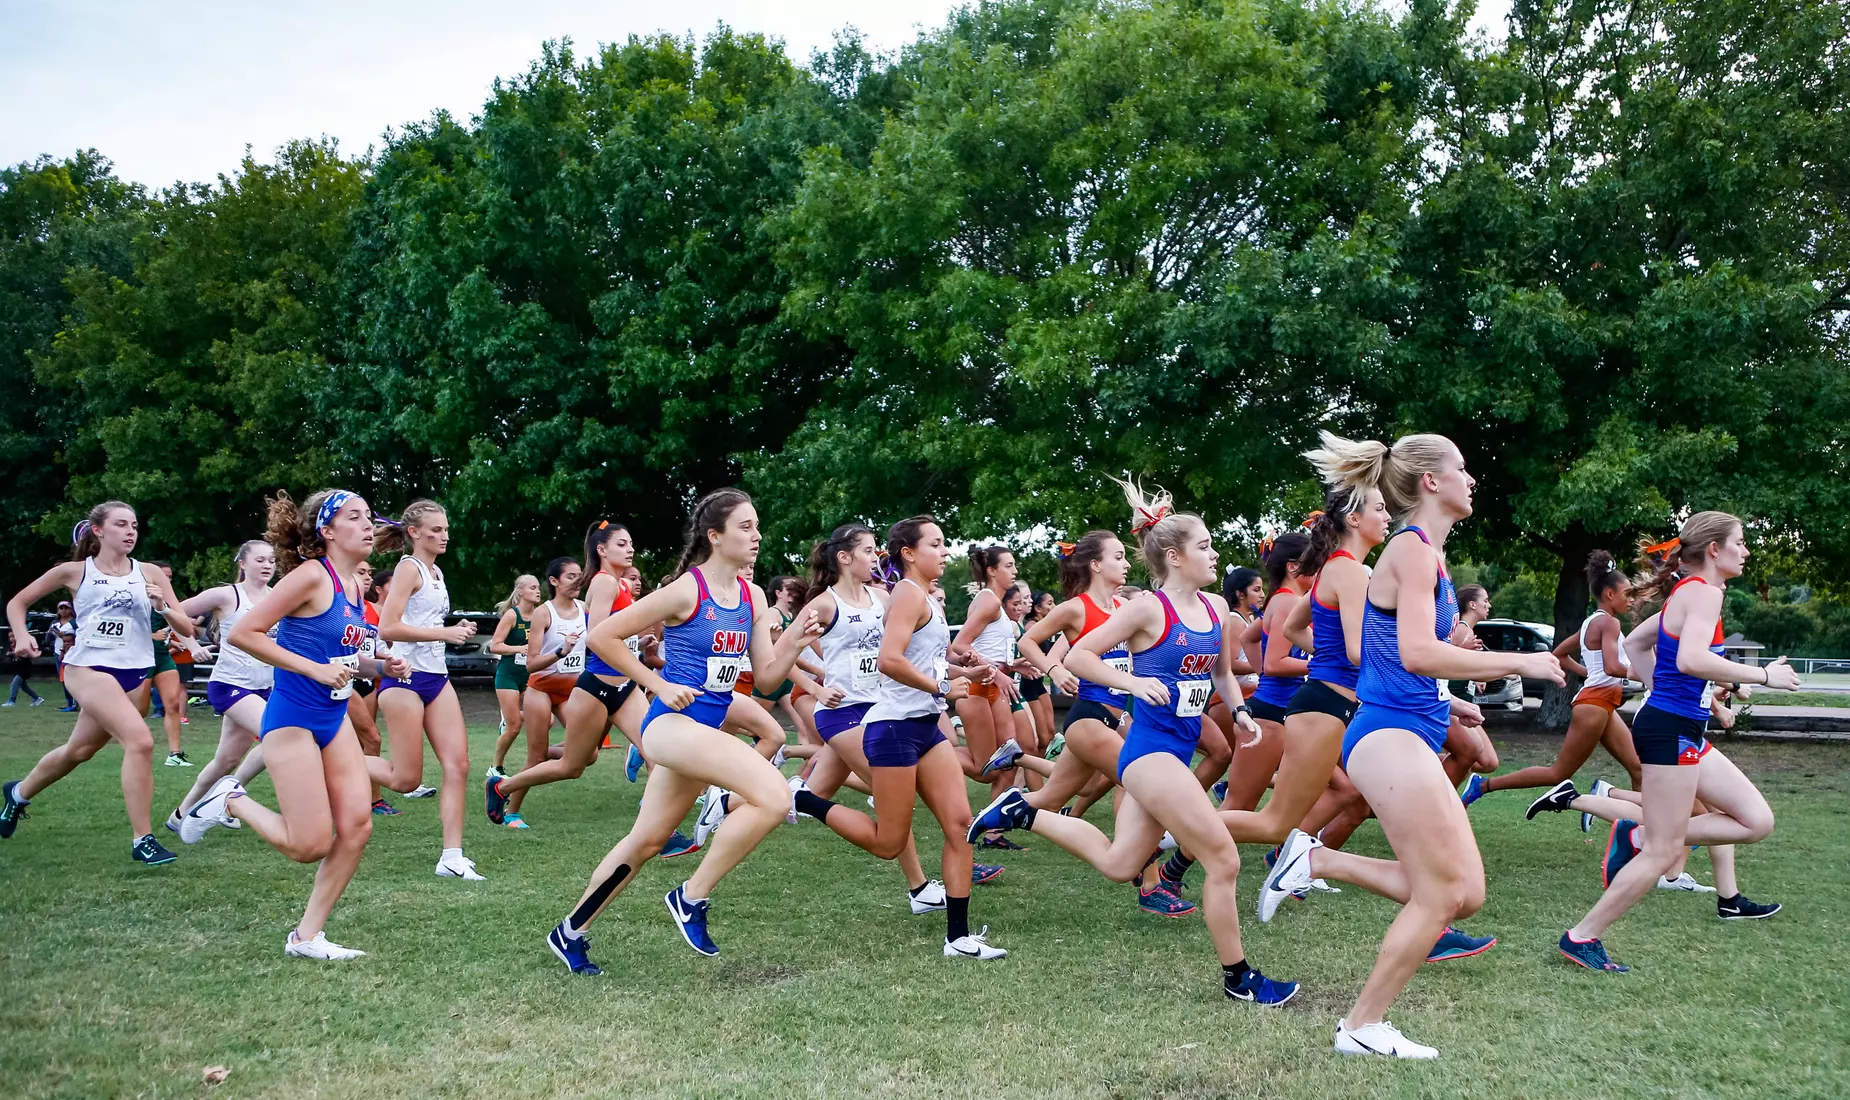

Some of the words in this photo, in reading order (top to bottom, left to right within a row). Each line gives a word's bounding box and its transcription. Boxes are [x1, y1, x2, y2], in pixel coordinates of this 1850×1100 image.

[96, 621, 124, 636] 429
[712, 629, 747, 653] SMU
[563, 656, 580, 667] 422
[860, 657, 877, 673] 427
[1180, 654, 1219, 675] SMU
[1188, 688, 1207, 708] 404
